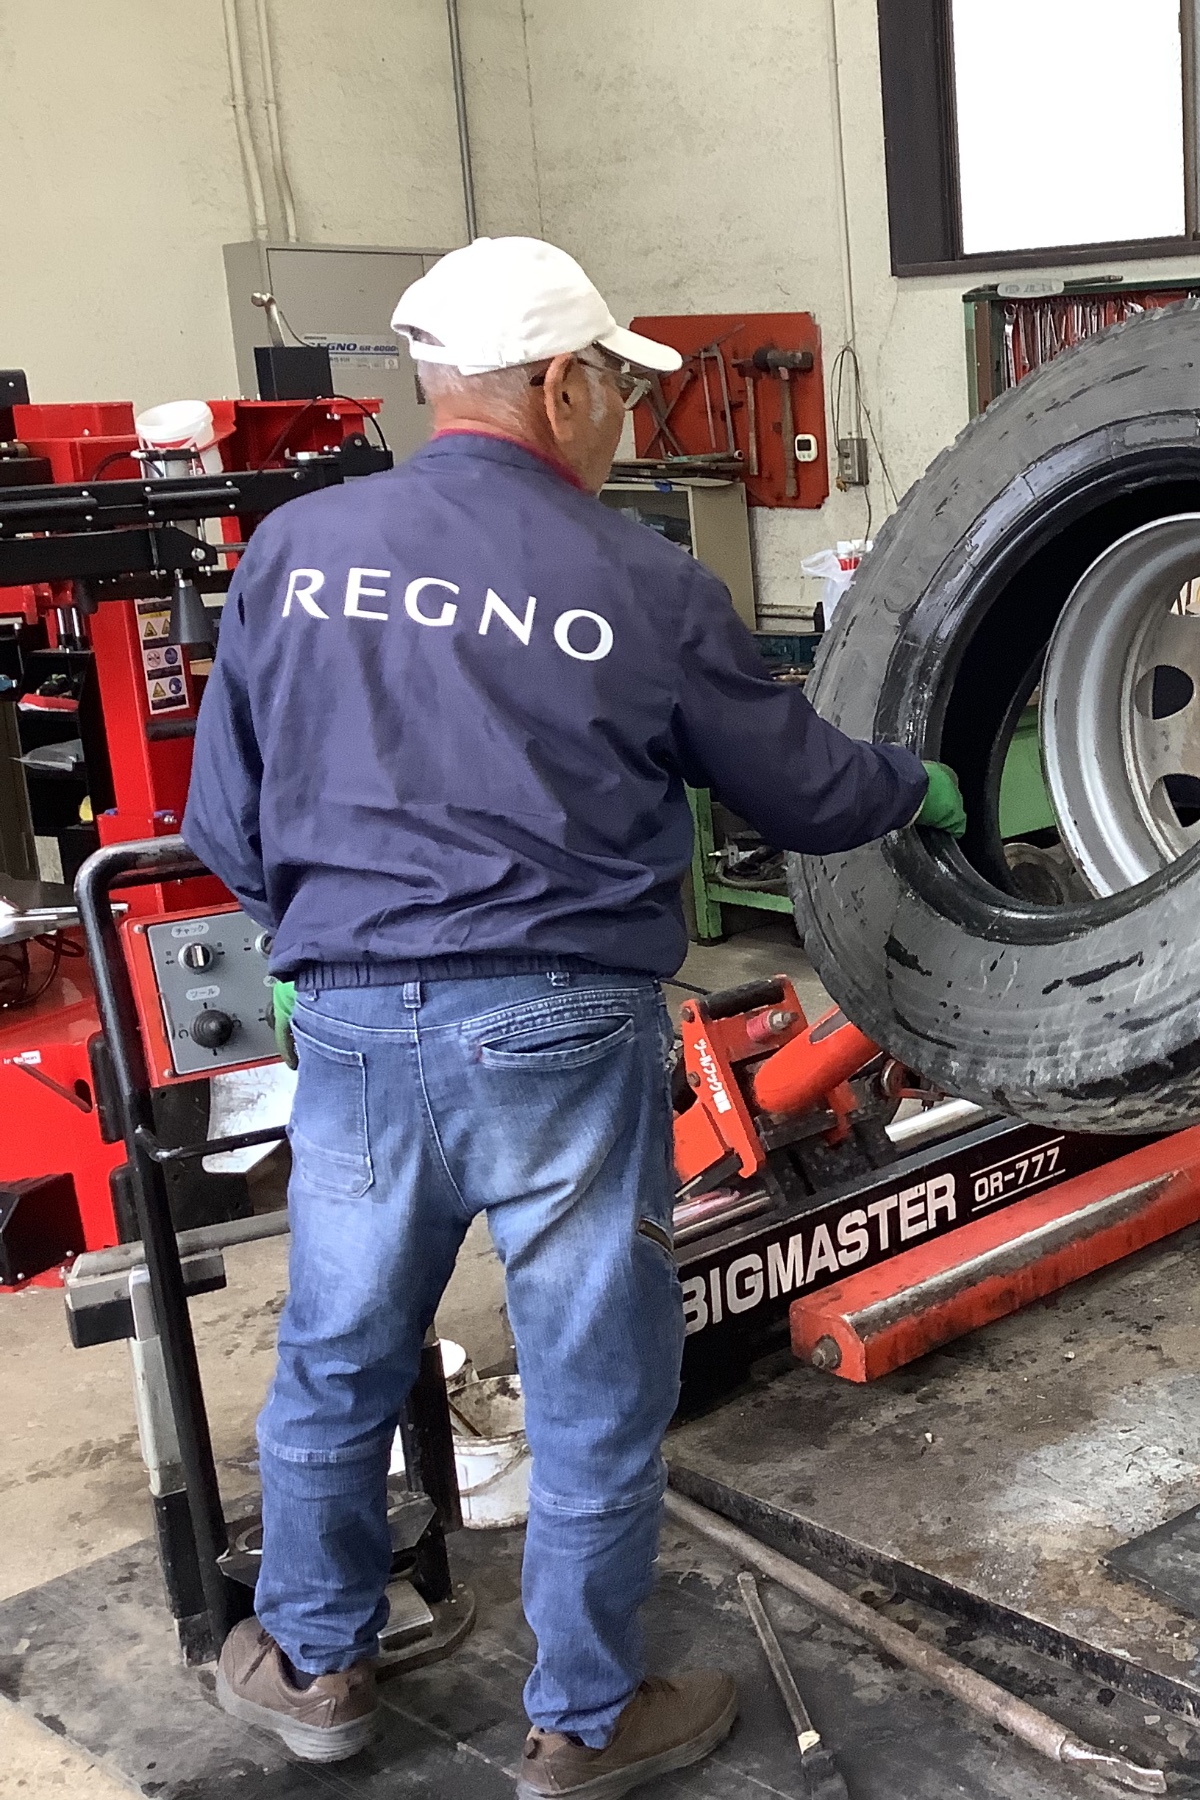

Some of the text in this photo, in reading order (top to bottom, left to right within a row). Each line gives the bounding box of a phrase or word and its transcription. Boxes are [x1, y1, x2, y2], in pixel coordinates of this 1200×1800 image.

[282, 567, 614, 661] REGNO
[680, 1146, 1060, 1336] BIGMASTER OR-777
